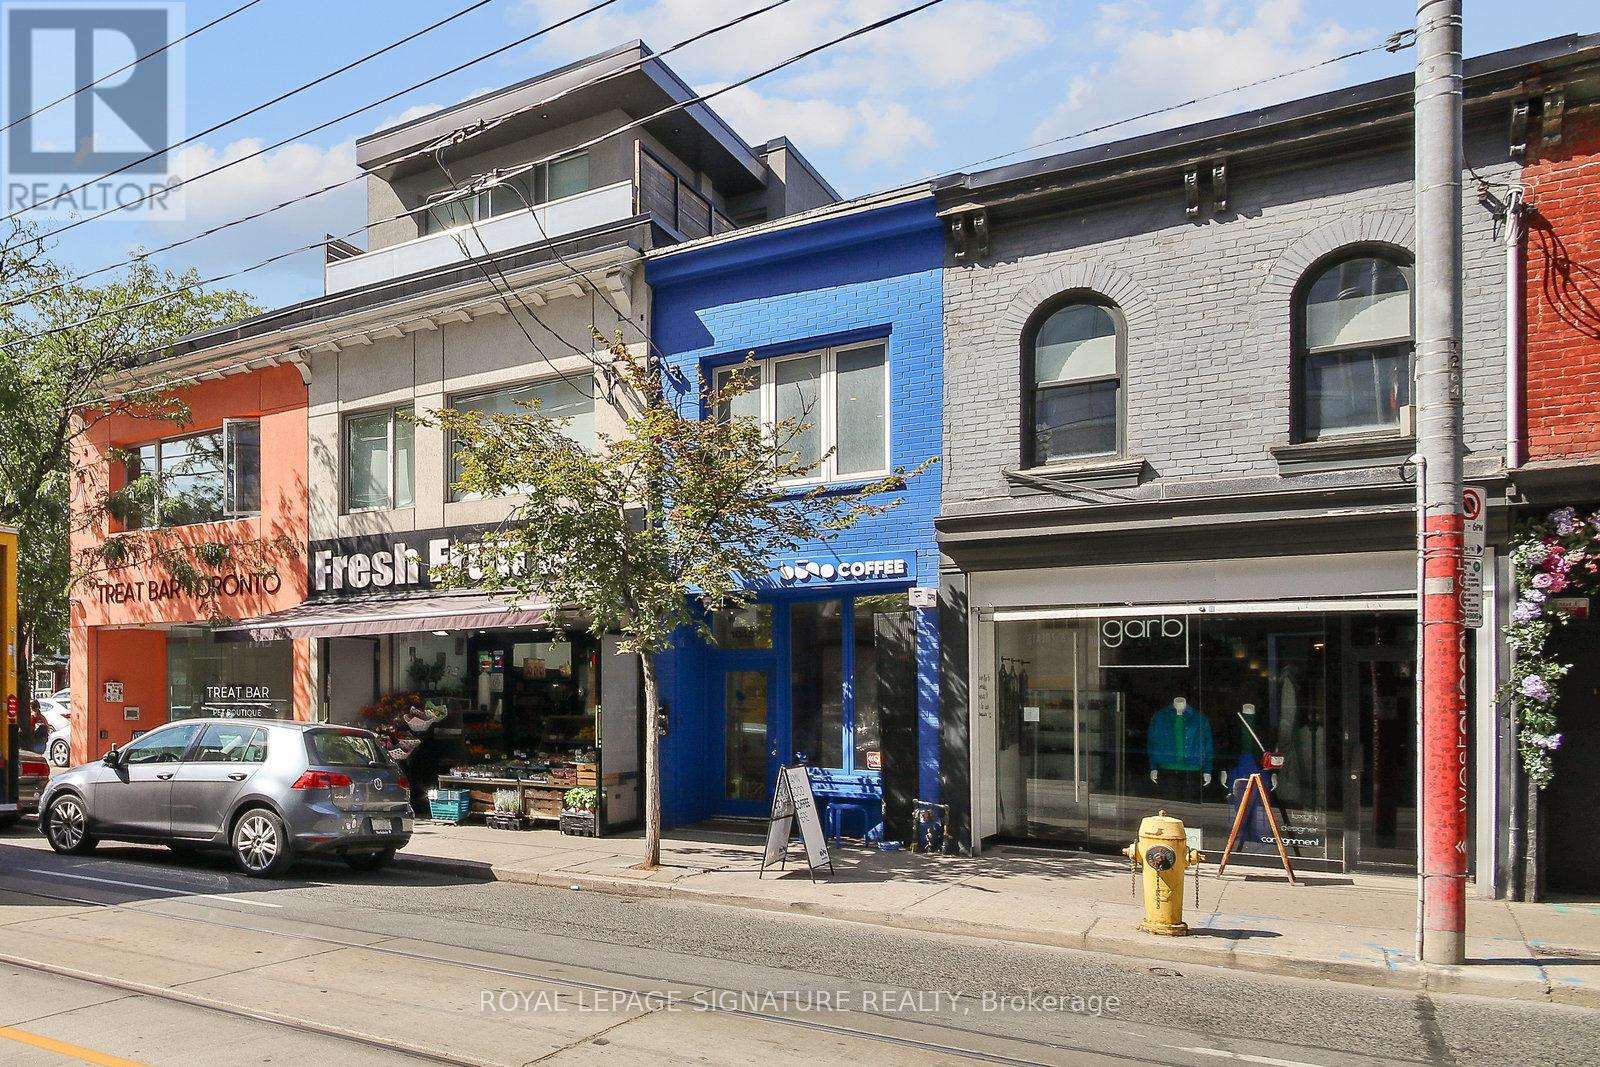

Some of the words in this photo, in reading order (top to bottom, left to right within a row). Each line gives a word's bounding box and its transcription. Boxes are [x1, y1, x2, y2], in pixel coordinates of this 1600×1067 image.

[315, 543, 420, 591] Fresh
[838, 559, 905, 577] COFFEE
[99, 582, 144, 604] TREAT
[149, 579, 181, 601] BAR
[1102, 615, 1184, 648] garb
[206, 686, 242, 699] TREAT
[245, 686, 270, 699] BAR
[1260, 836, 1320, 847] congnment
